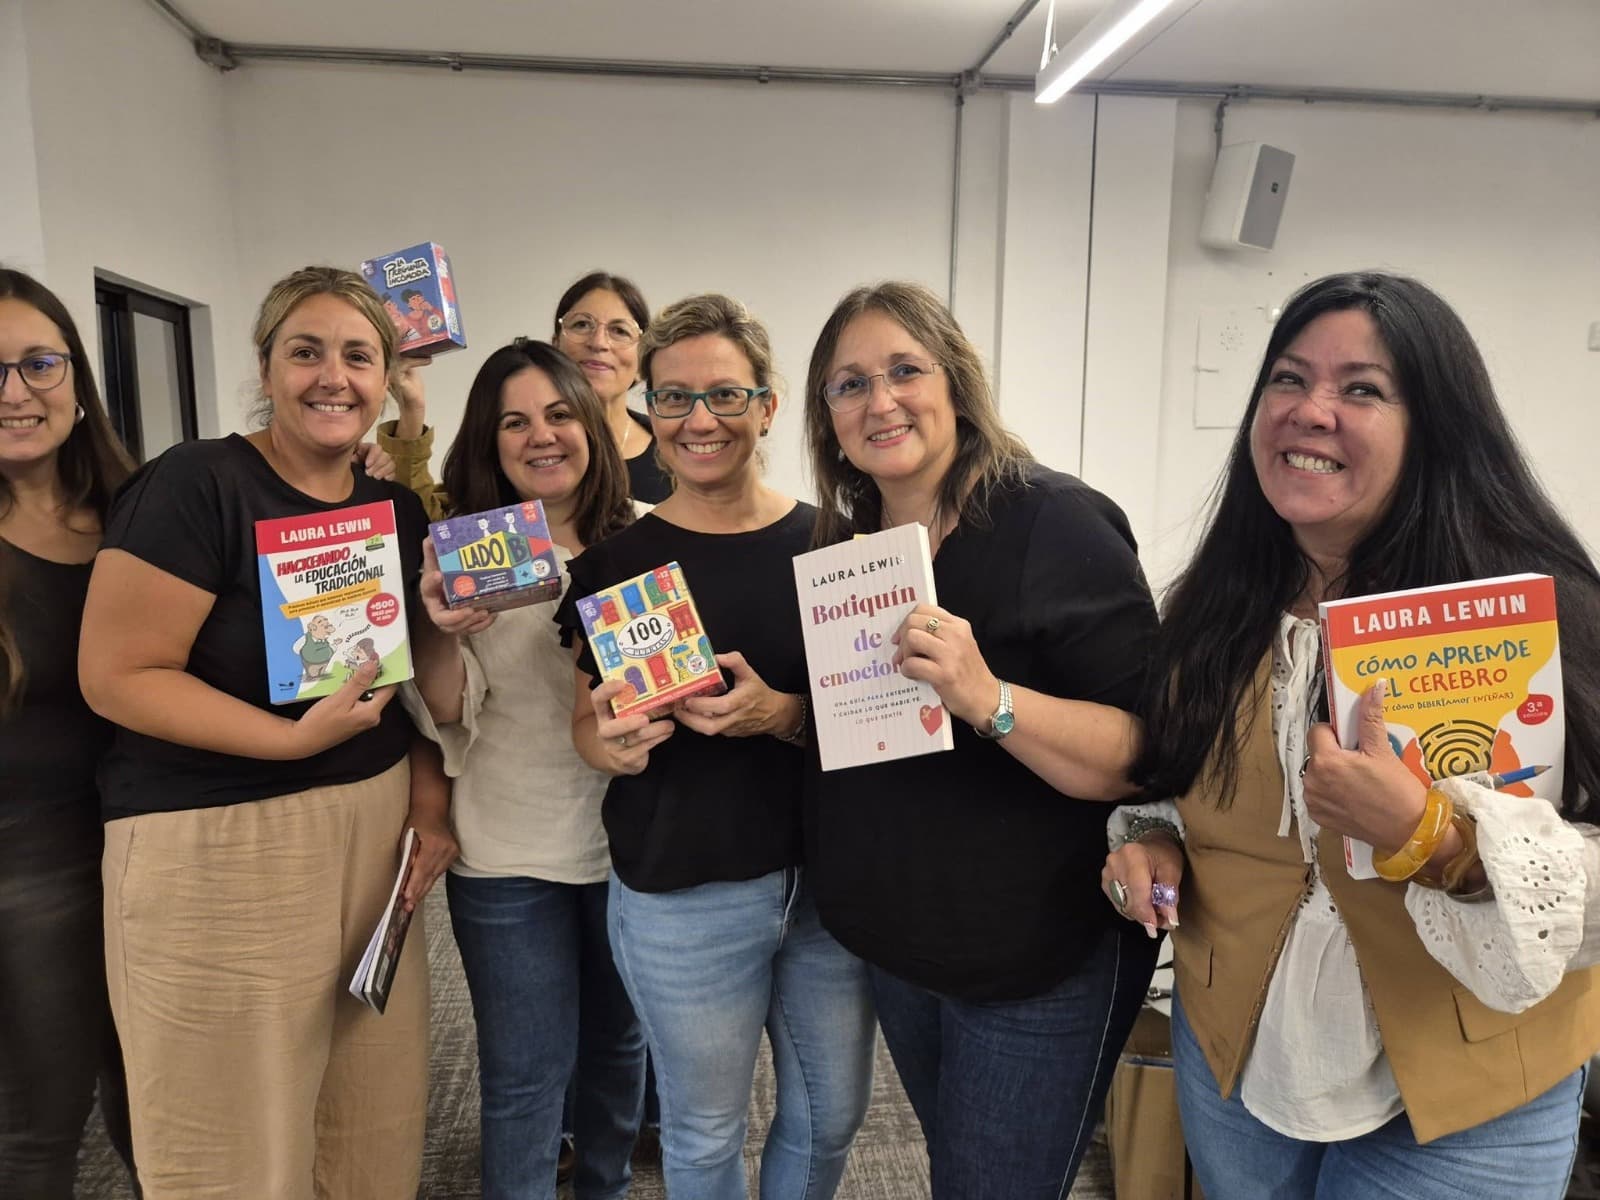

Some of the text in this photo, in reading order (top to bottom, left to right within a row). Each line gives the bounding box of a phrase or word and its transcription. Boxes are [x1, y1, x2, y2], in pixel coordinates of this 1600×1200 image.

[281, 518, 371, 544] LAURA LEWIN
[277, 546, 351, 576] HACKEANDO
[463, 538, 505, 569] LADO
[508, 536, 528, 563] B
[294, 553, 367, 584] LA EDUCACIÓN
[314, 564, 385, 594] TRADICIONAL
[812, 568, 855, 587] LAURA
[370, 599, 395, 610] +500
[812, 584, 916, 625] Botiquín
[1353, 593, 1527, 635] LAURA LEWIN
[627, 617, 662, 646] 100
[854, 628, 882, 652] de
[1356, 639, 1531, 676] CÓMO APRENDE
[1409, 668, 1508, 694] CEREBRO
[875, 703, 888, 711] QUE
